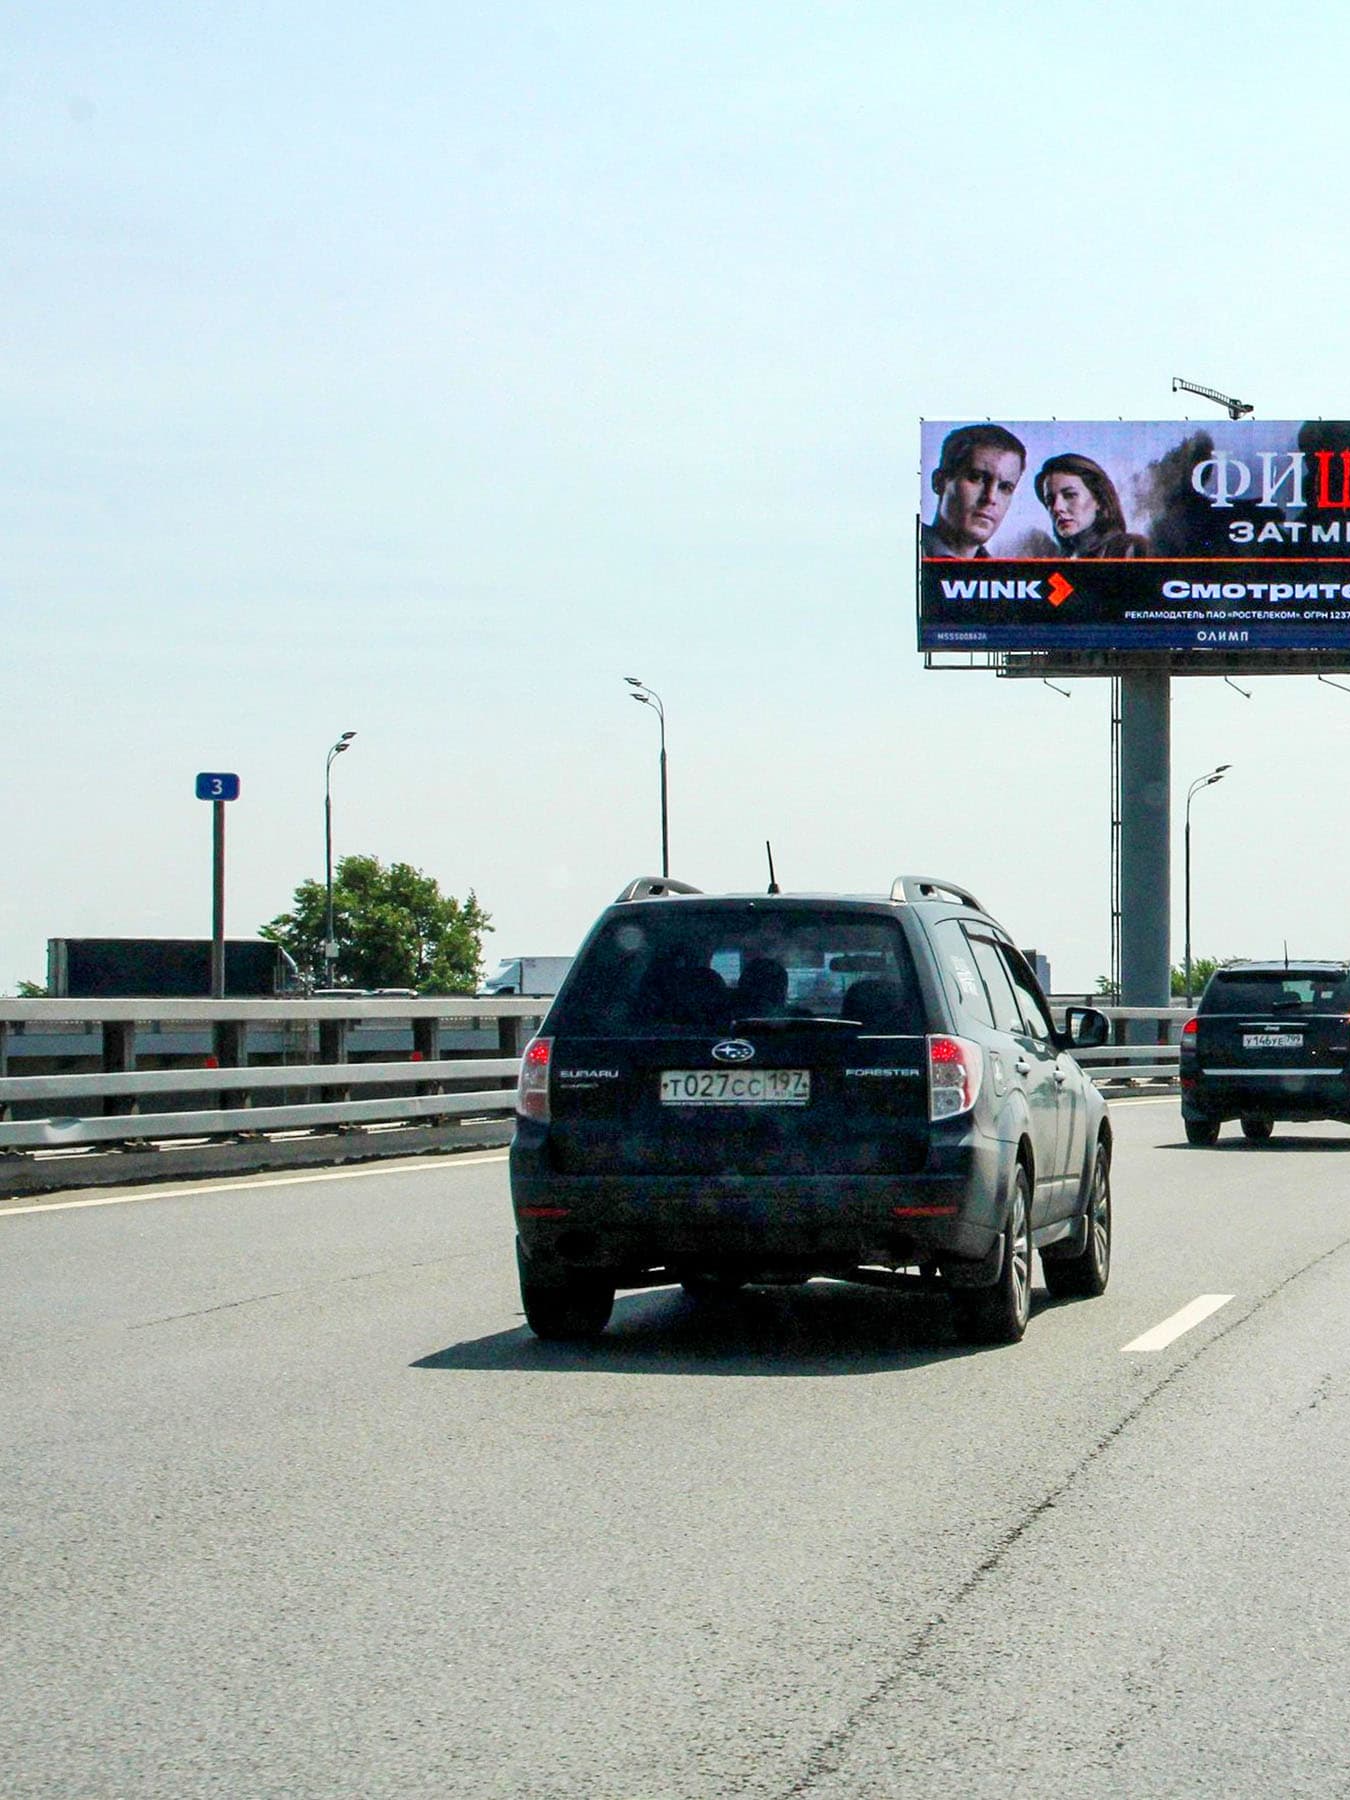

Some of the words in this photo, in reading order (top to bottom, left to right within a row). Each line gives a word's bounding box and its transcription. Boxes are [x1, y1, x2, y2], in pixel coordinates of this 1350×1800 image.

[941, 580, 1042, 599] WINK
[1125, 611, 1204, 619] РЕКЛАМОДАТЕЛЬ
[1206, 611, 1226, 619] ПАО
[1303, 611, 1328, 619] ОГРН
[1197, 631, 1249, 641] ОЛИМП
[211, 779, 223, 795] 3
[560, 1070, 619, 1078] SUBARU
[846, 1069, 919, 1077] FORESTER
[767, 1072, 803, 1090] 197
